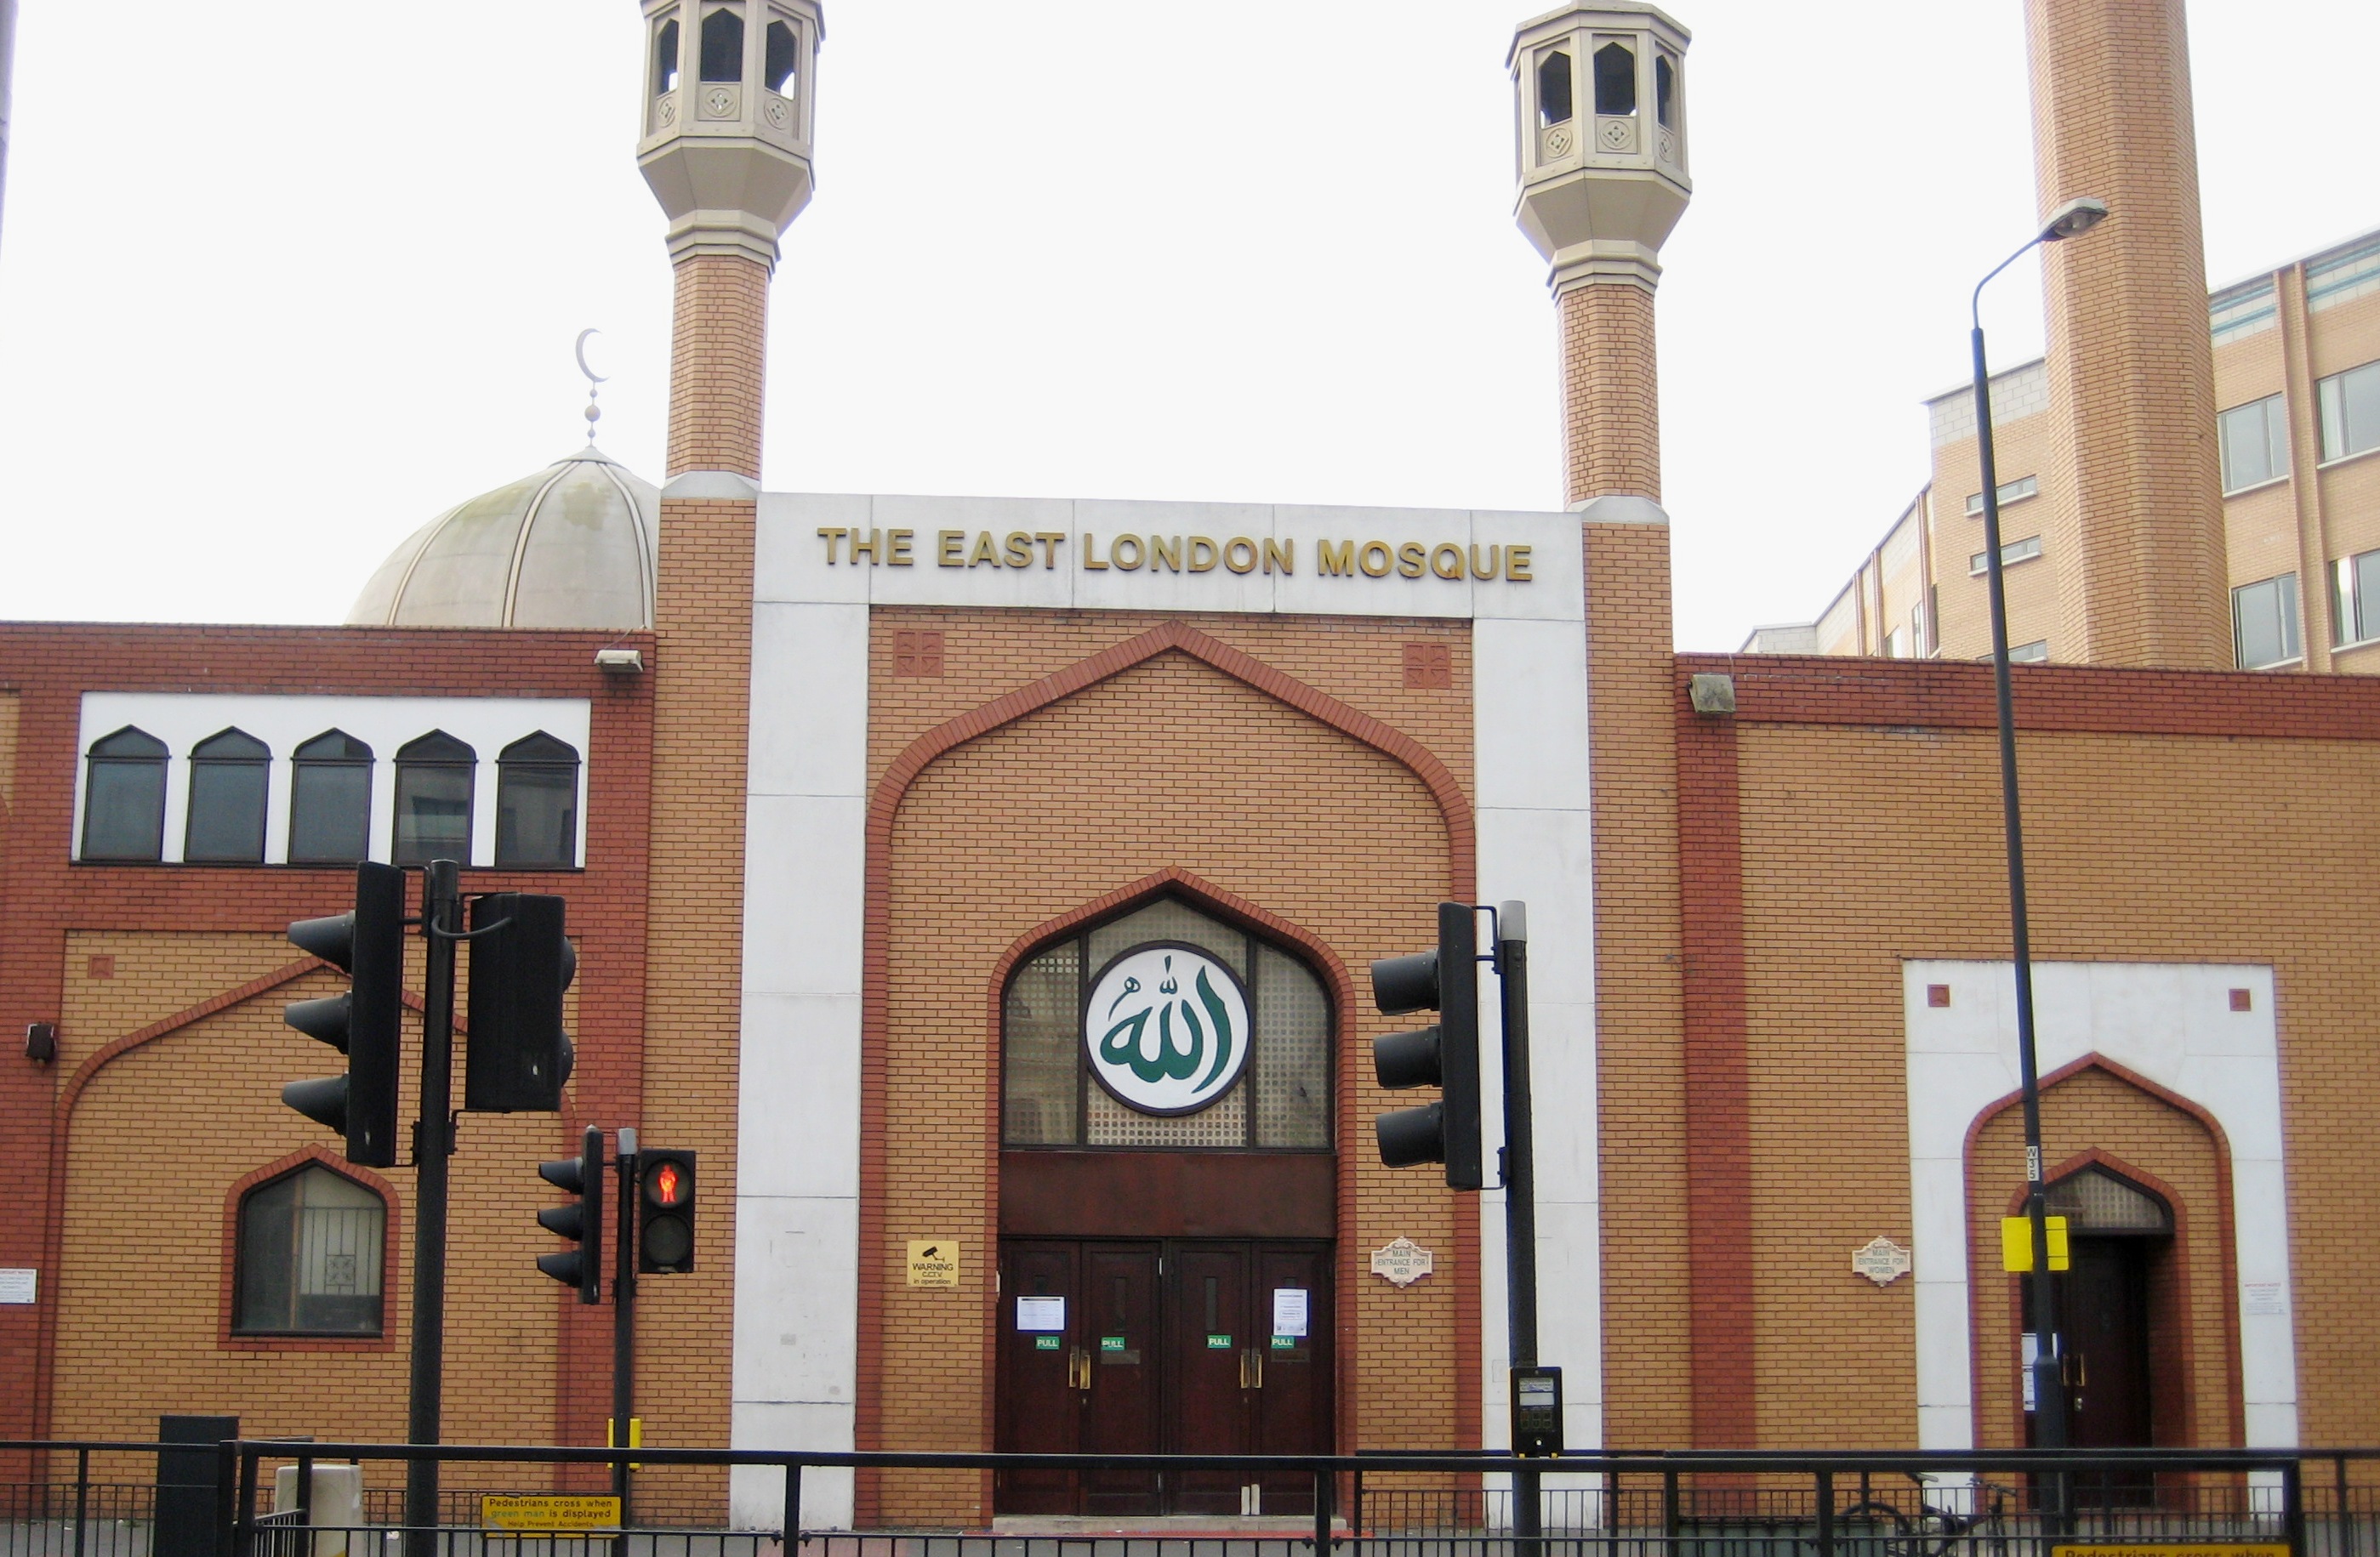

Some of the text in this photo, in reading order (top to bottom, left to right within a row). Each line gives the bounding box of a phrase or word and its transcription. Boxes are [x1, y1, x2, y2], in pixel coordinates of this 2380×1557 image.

[817, 527, 1533, 582] THE EAST LONDON MOSQUE
[912, 1263, 954, 1271] WARNING
[489, 1497, 549, 1507] Pedestrians
[586, 1498, 612, 1507] when
[562, 1509, 611, 1519] displayed
